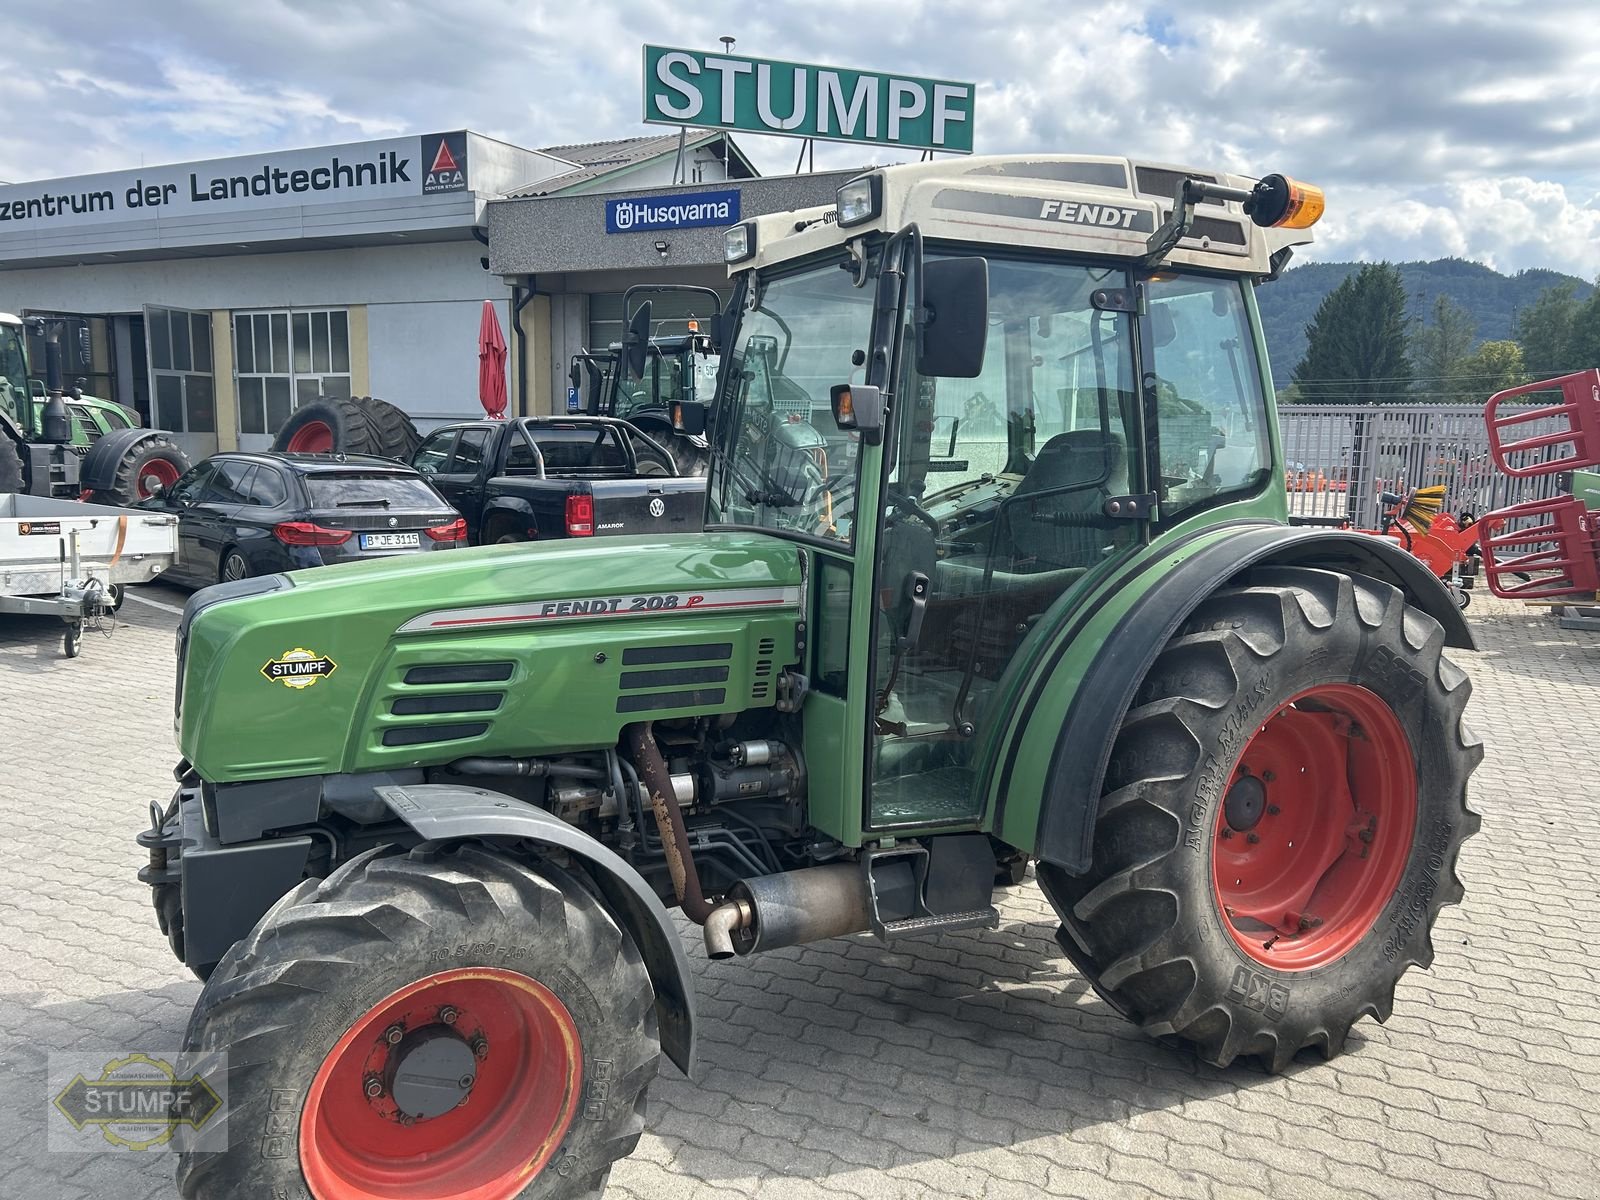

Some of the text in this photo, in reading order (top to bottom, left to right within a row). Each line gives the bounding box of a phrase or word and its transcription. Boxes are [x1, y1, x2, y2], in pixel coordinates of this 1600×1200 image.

[654, 51, 969, 144] STUMPF
[0, 151, 412, 221] zentrum der Landtechnik
[425, 170, 464, 186] ACA
[634, 201, 729, 225] Husqvarna
[1039, 200, 1138, 229] FENDT
[705, 365, 714, 376] 50
[569, 389, 575, 398] P
[367, 534, 418, 546] B JE 3115
[541, 595, 704, 617] FENDT 208 P
[272, 662, 326, 675] STUMPF
[1184, 752, 1221, 852] AGRI
[1228, 968, 1290, 1020] BKT
